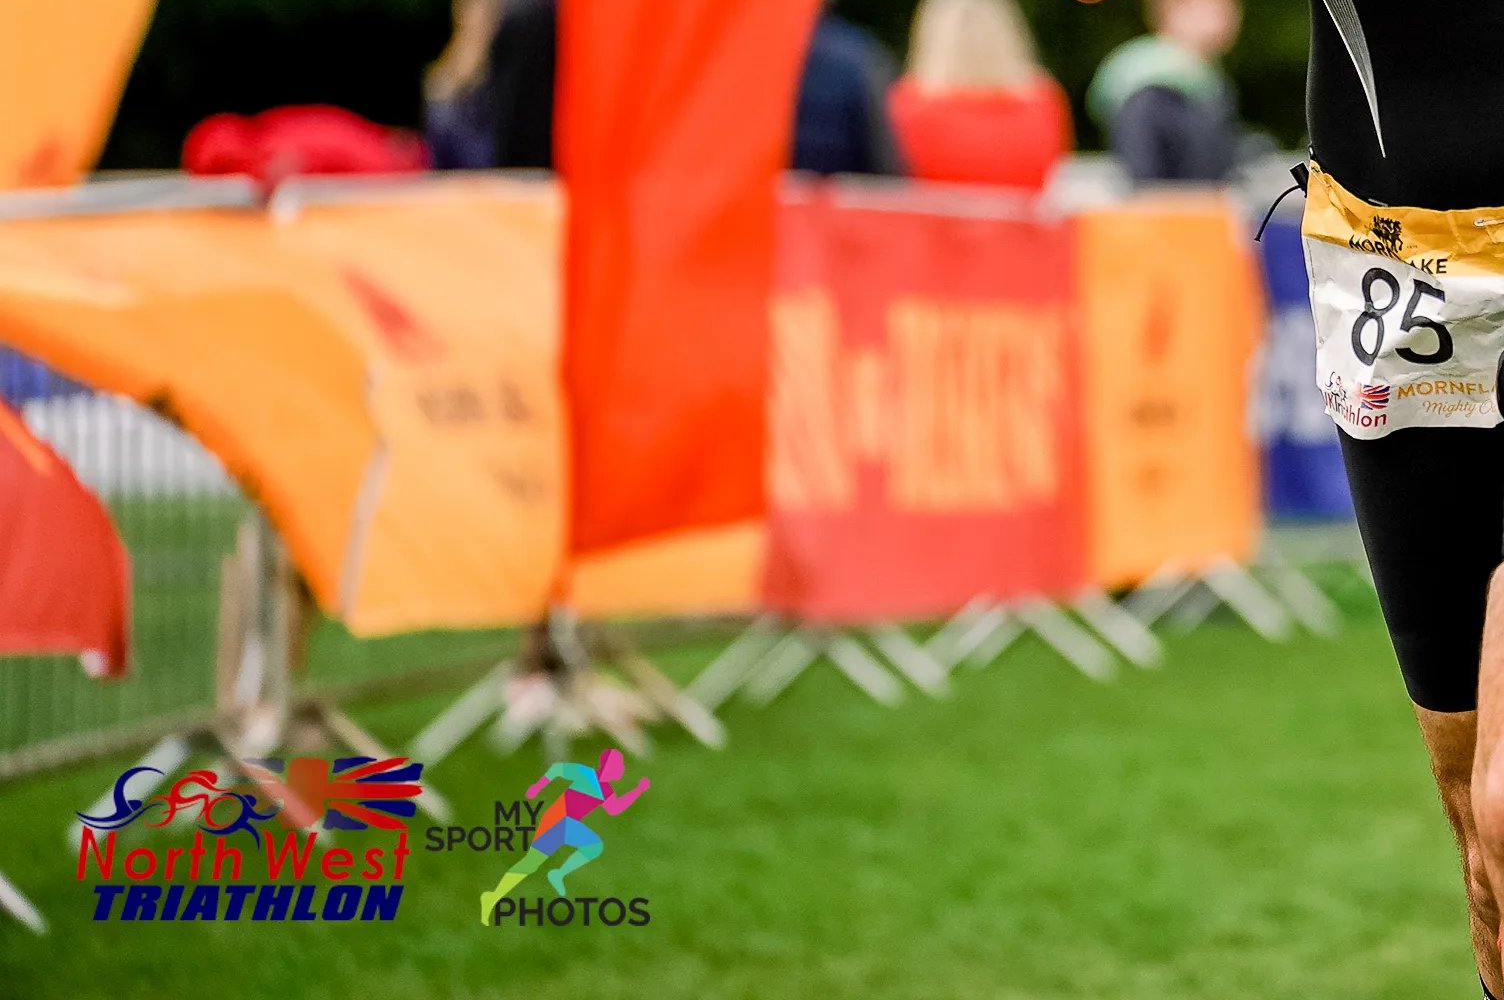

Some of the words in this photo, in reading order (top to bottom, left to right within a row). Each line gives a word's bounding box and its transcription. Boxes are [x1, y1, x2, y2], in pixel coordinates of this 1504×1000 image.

[1351, 267, 1454, 366] 85
[1397, 381, 1496, 400] MORNFL
[1422, 400, 1475, 418] Mighty
